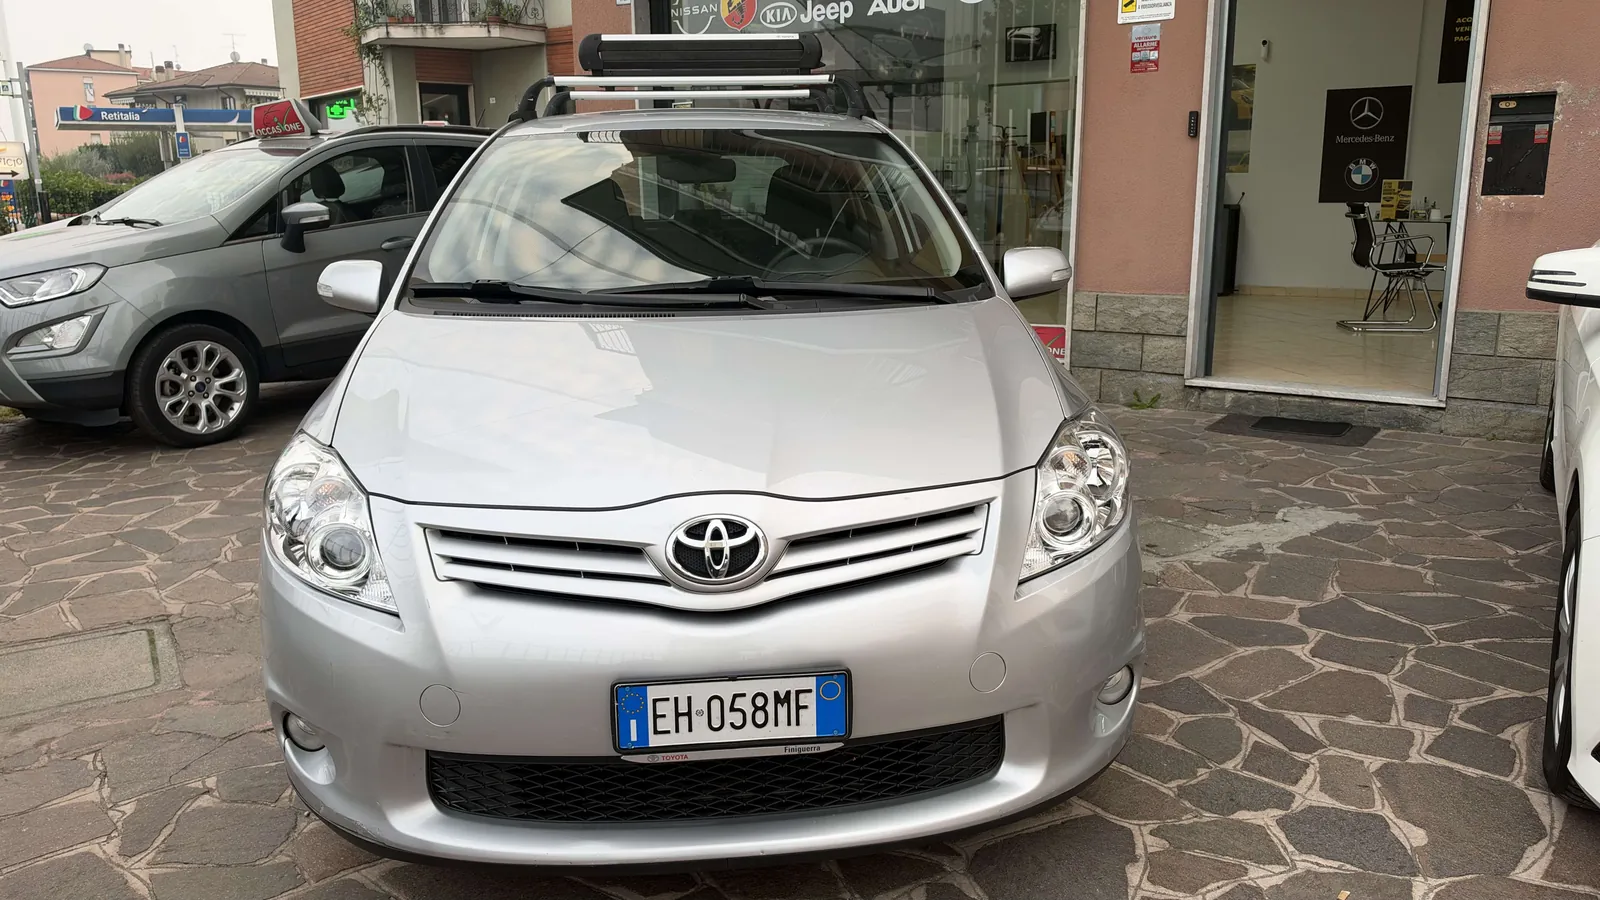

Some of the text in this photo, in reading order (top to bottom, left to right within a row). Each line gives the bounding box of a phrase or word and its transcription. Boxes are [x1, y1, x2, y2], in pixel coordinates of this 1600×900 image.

[671, 3, 718, 17] NISSAN
[766, 7, 791, 23] KIA
[800, 0, 854, 24] Jeep
[101, 111, 140, 121] Retitalia
[1335, 134, 1395, 144] Mercedes-Benz
[1348, 158, 1377, 170] BMW
[784, 745, 821, 754] Finiguerra
[661, 754, 689, 762] TOYOTA
